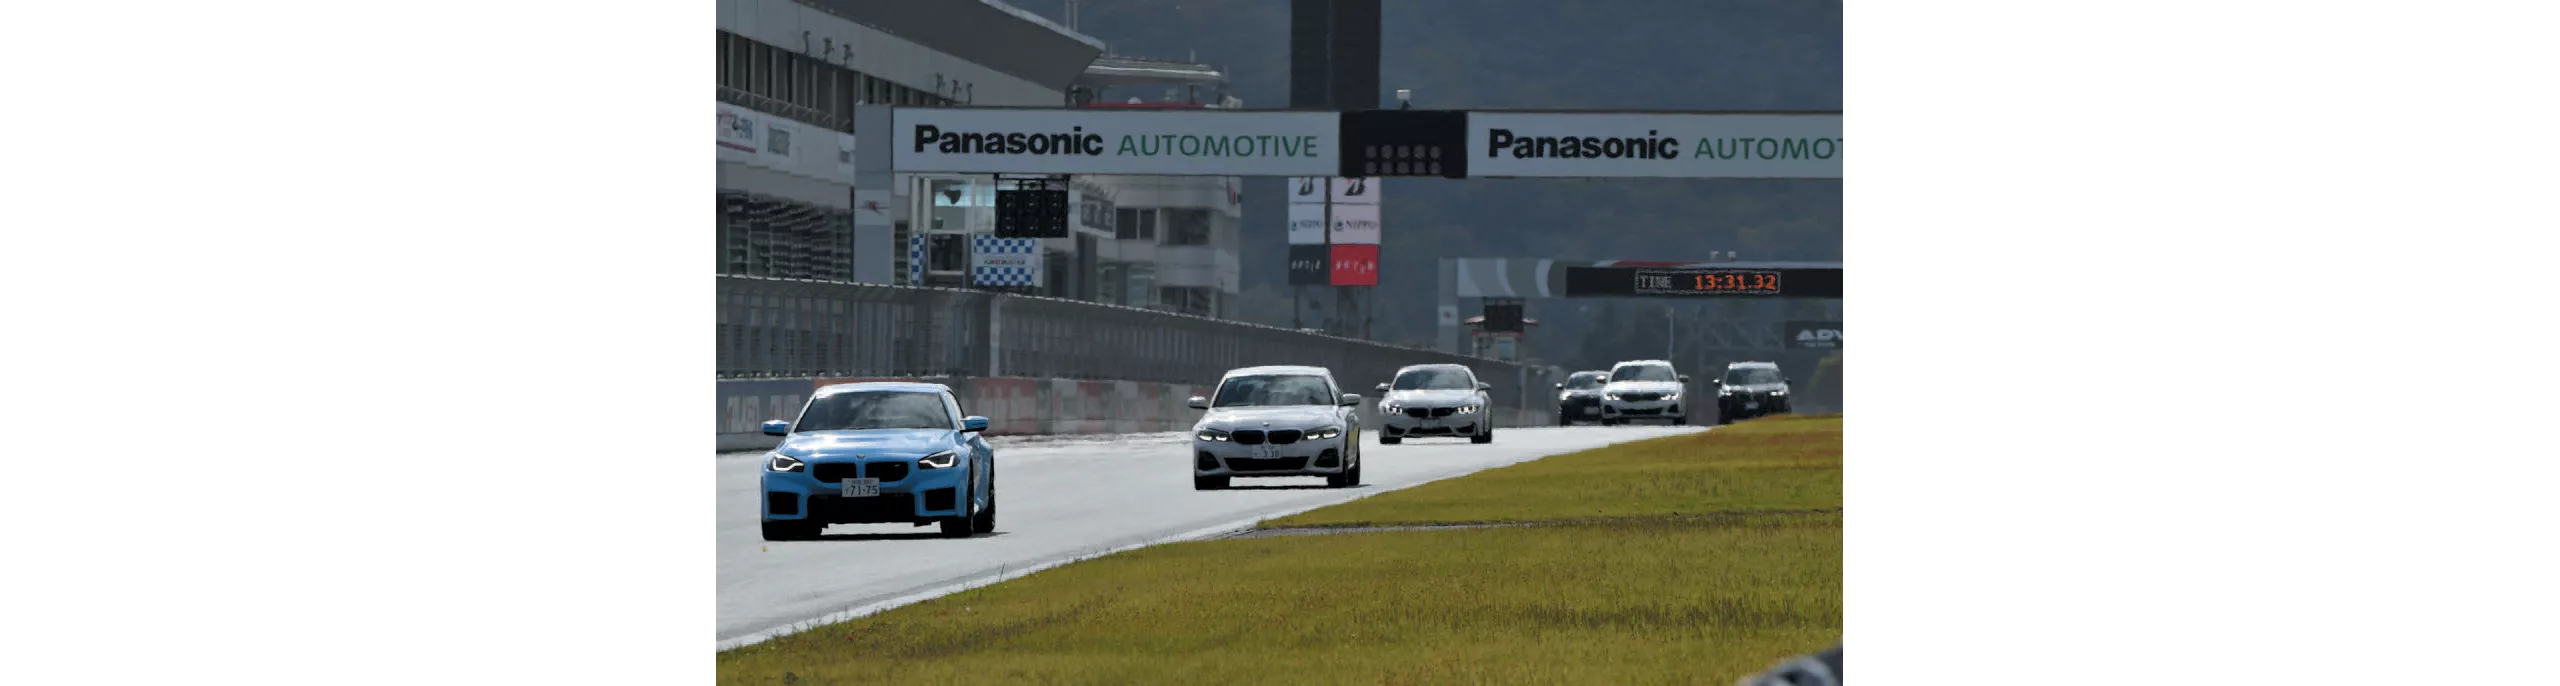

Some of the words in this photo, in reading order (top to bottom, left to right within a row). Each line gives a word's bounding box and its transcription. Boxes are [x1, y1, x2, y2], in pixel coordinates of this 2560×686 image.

[914, 124, 1103, 156] Panasonic
[1116, 134, 1318, 157] AUTOMOTIVE
[1488, 128, 1679, 160] Panasonic
[1639, 275, 1671, 290] TIME
